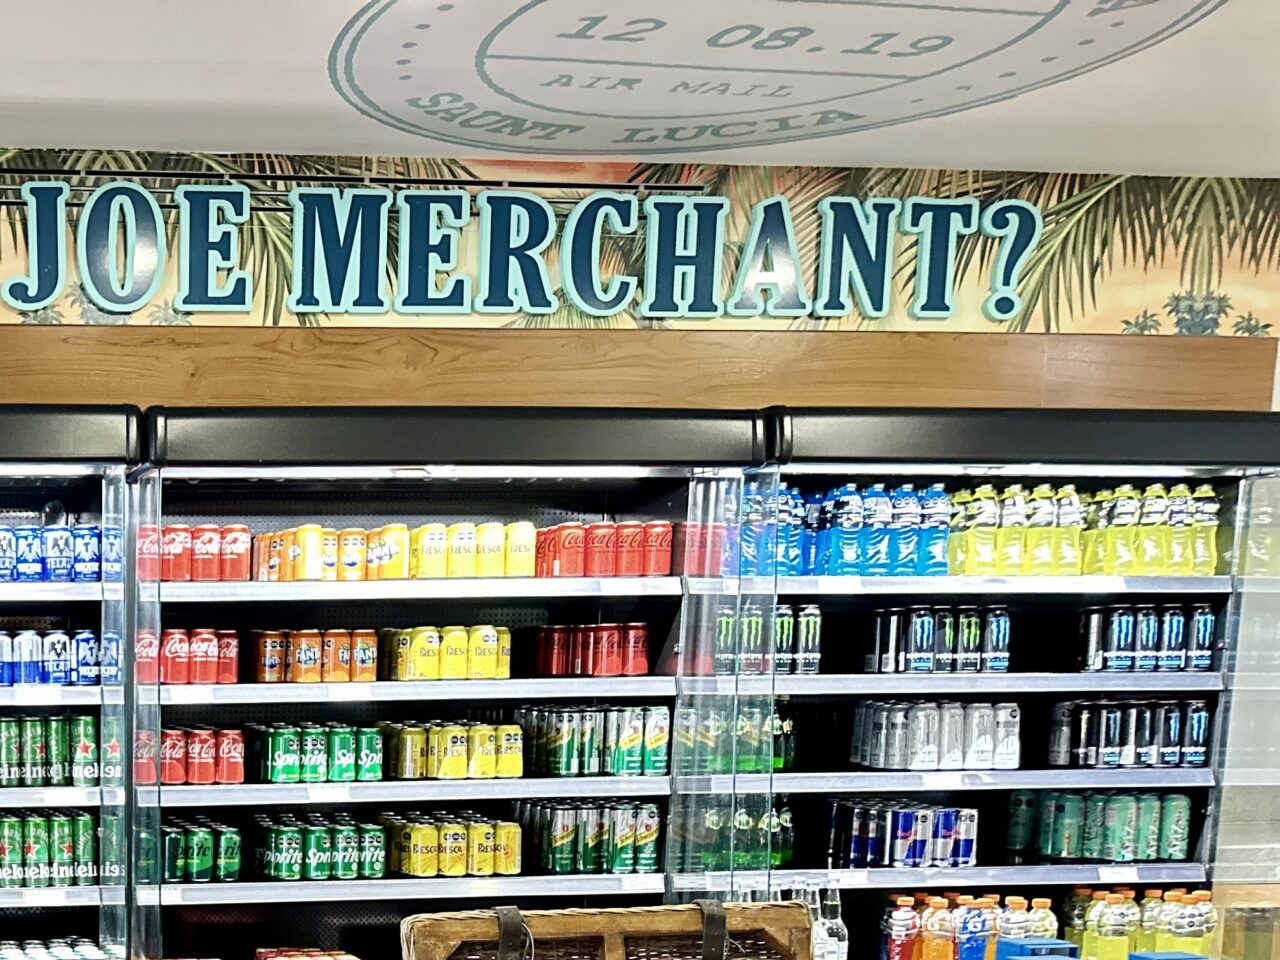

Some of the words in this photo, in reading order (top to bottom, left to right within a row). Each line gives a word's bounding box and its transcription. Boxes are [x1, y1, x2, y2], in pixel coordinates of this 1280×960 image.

[556, 15, 668, 42] 12
[706, 24, 954, 57] 08.19
[539, 74, 643, 90] AIR
[669, 81, 794, 97] MAIL
[612, 108, 865, 143] LUCIA
[2, 180, 255, 315] JOE
[287, 186, 1044, 320] MERCHANT?
